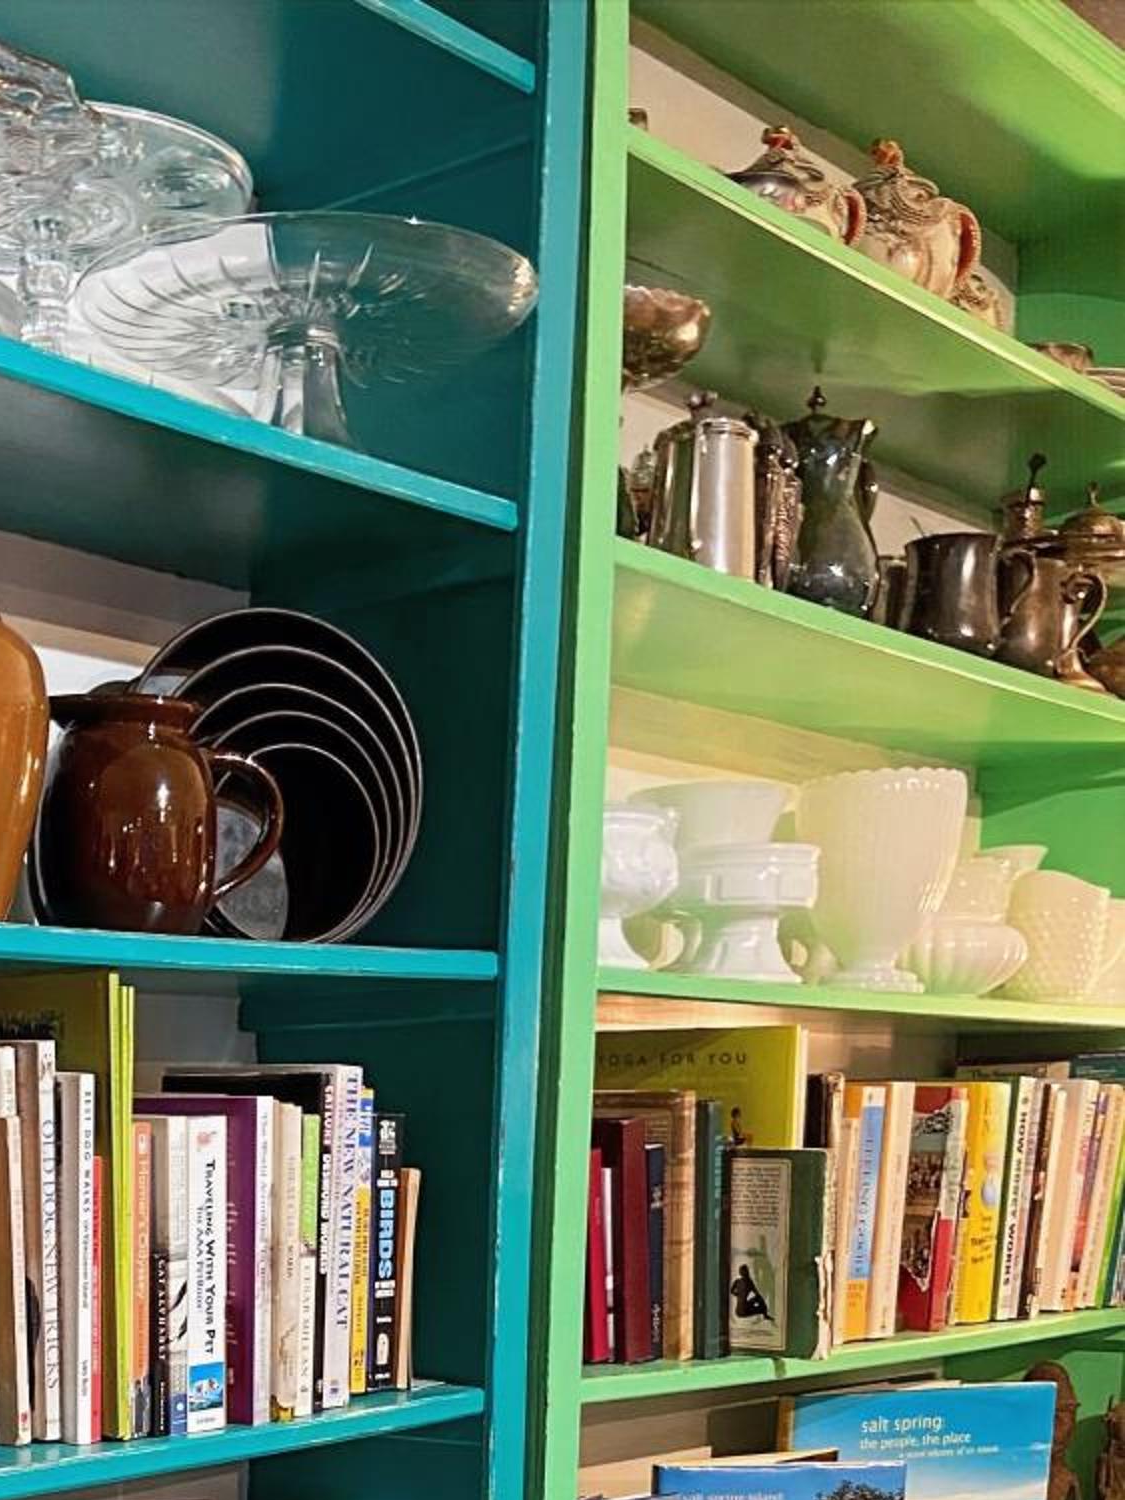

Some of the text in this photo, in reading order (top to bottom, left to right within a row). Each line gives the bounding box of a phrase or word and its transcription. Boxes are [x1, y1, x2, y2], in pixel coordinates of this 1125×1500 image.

[659, 1052, 749, 1066] FOR YOU
[83, 1169, 92, 1214] WALKS
[335, 1074, 359, 1330] THE NEW NATURAL CAT
[45, 1302, 59, 1390] TRICKS
[860, 1431, 971, 1450] the the place
[861, 1415, 943, 1434] salt spring
